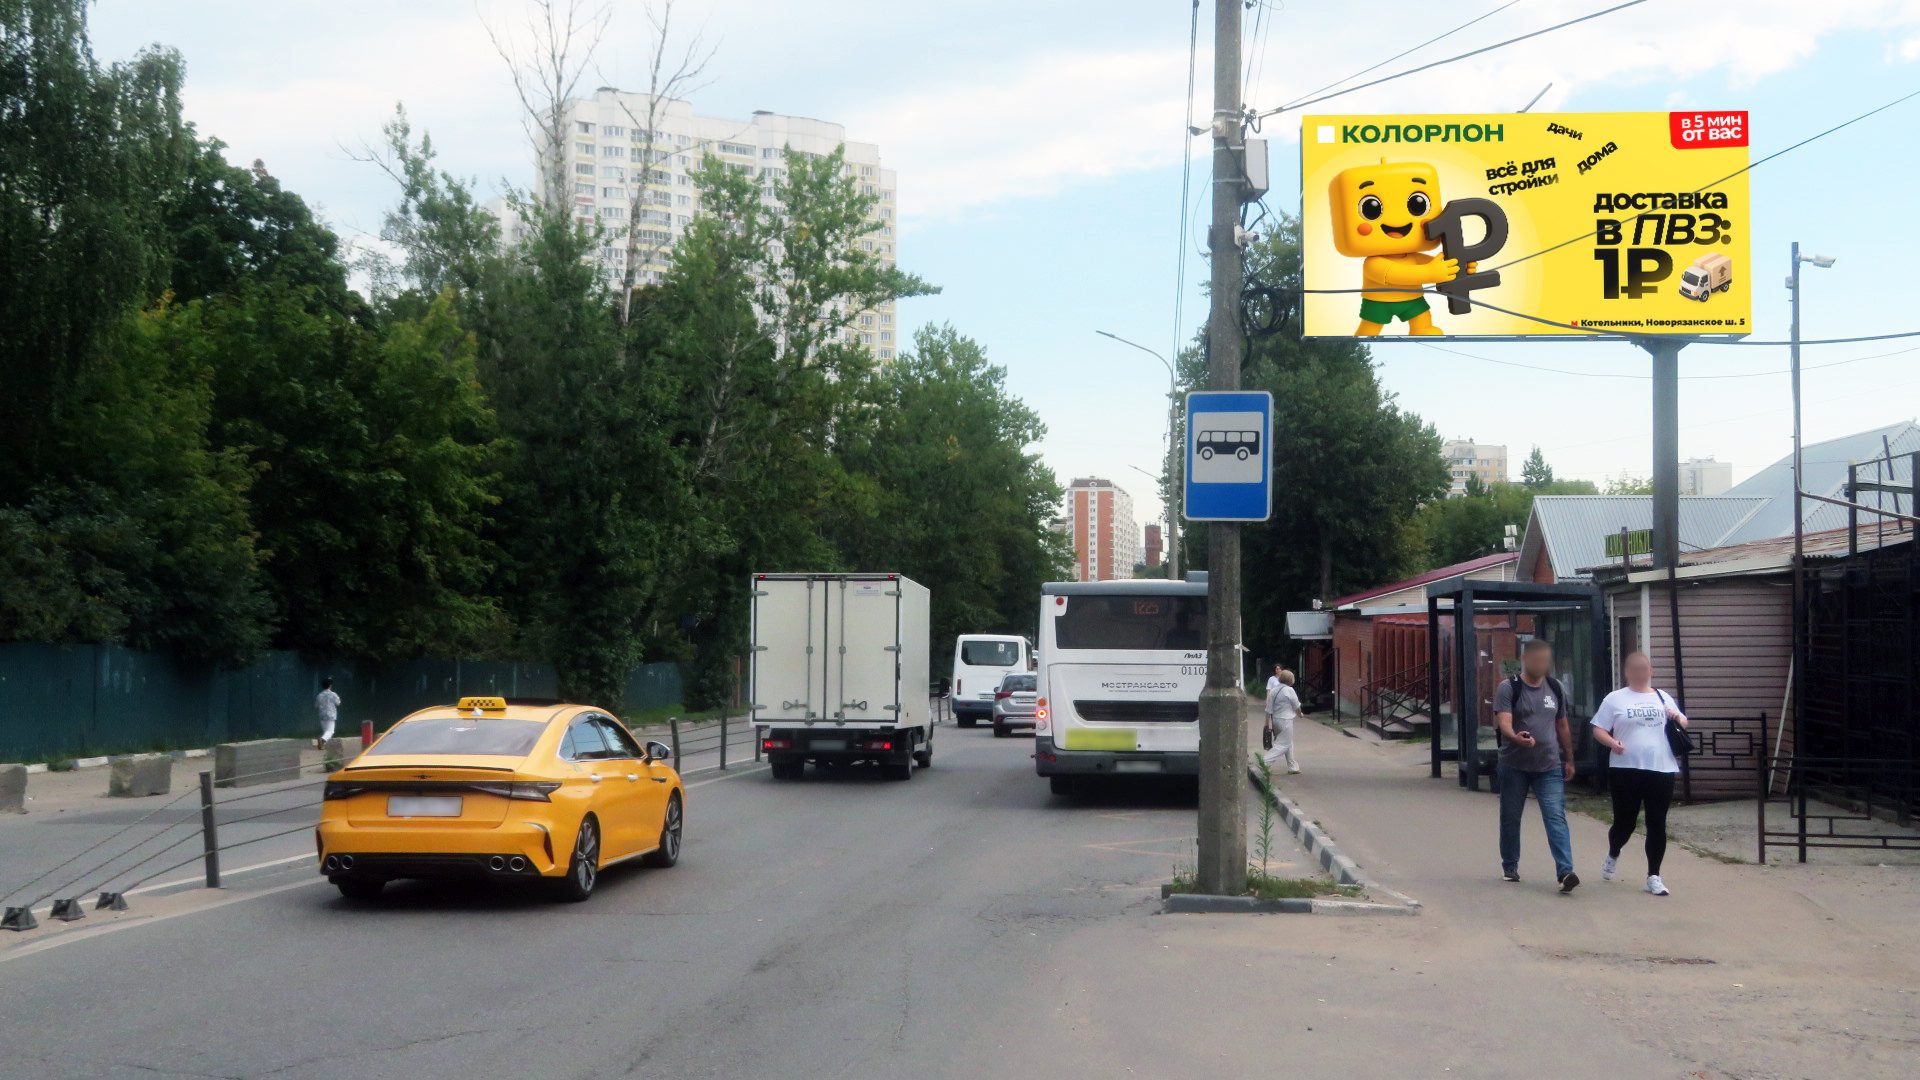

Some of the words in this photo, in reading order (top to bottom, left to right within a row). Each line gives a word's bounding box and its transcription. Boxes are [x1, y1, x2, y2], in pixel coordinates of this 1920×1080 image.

[1546, 122, 1583, 141] дачи
[1681, 118, 1691, 129] в
[1694, 114, 1704, 128] 5
[1707, 115, 1742, 128] мин
[1342, 123, 1504, 144] КОЛОРЛОН
[1682, 128, 1705, 142] от
[1708, 126, 1742, 140] вас
[1486, 160, 1518, 181] всё
[1521, 157, 1556, 176] для
[1577, 141, 1618, 176] дома
[1488, 173, 1559, 196] стройки
[1593, 192, 1728, 214] доставка
[1596, 218, 1623, 246] в
[1631, 212, 1732, 246] ПВЗ:
[1581, 318, 1644, 328] Котельники,
[1646, 318, 1723, 328] Новорязанское
[1725, 318, 1737, 326] ш.
[1739, 318, 1746, 326] 5
[1627, 708, 1665, 719] EXCLUSIV
